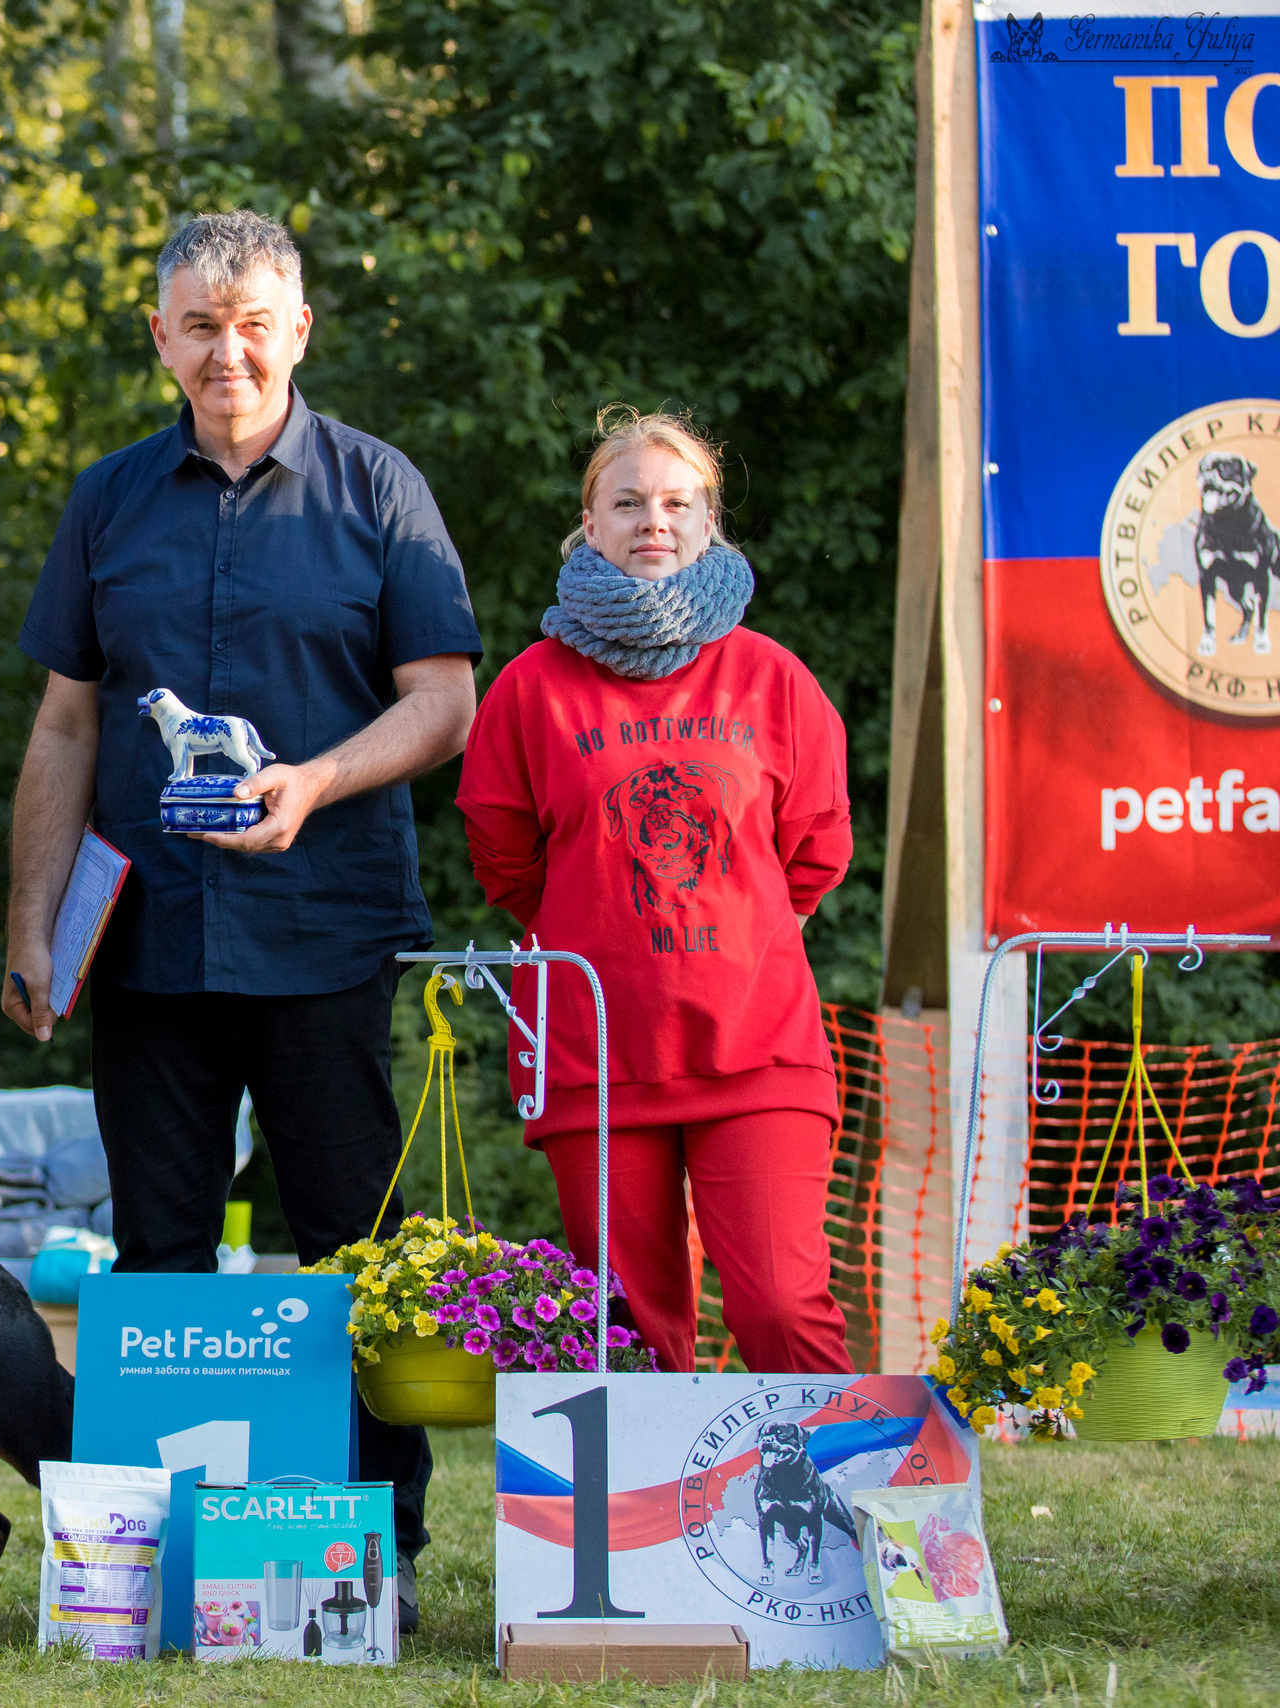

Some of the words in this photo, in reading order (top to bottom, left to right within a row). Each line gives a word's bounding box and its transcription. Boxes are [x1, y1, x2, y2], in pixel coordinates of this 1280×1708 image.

[1116, 230, 1280, 338] ГО
[1116, 418, 1223, 626] РОТВЕЙЛЕР
[574, 727, 605, 757] NO
[1101, 769, 1280, 851] petfa
[651, 927, 674, 953] NO
[684, 926, 718, 952] LIFE
[121, 1326, 176, 1358] Pet
[183, 1326, 291, 1359] Fabric
[120, 1367, 152, 1376] умная
[155, 1364, 190, 1375] забота
[193, 1367, 200, 1375] о
[202, 1367, 236, 1375] ваших
[239, 1367, 291, 1377] питомцах
[684, 1392, 781, 1561] РОТВЕЙЛЕР
[801, 1388, 885, 1426] КЛУБ
[532, 1386, 645, 1618] 1
[61, 1533, 105, 1543] COMPLEX
[747, 1590, 873, 1621] РКФ-НКП
